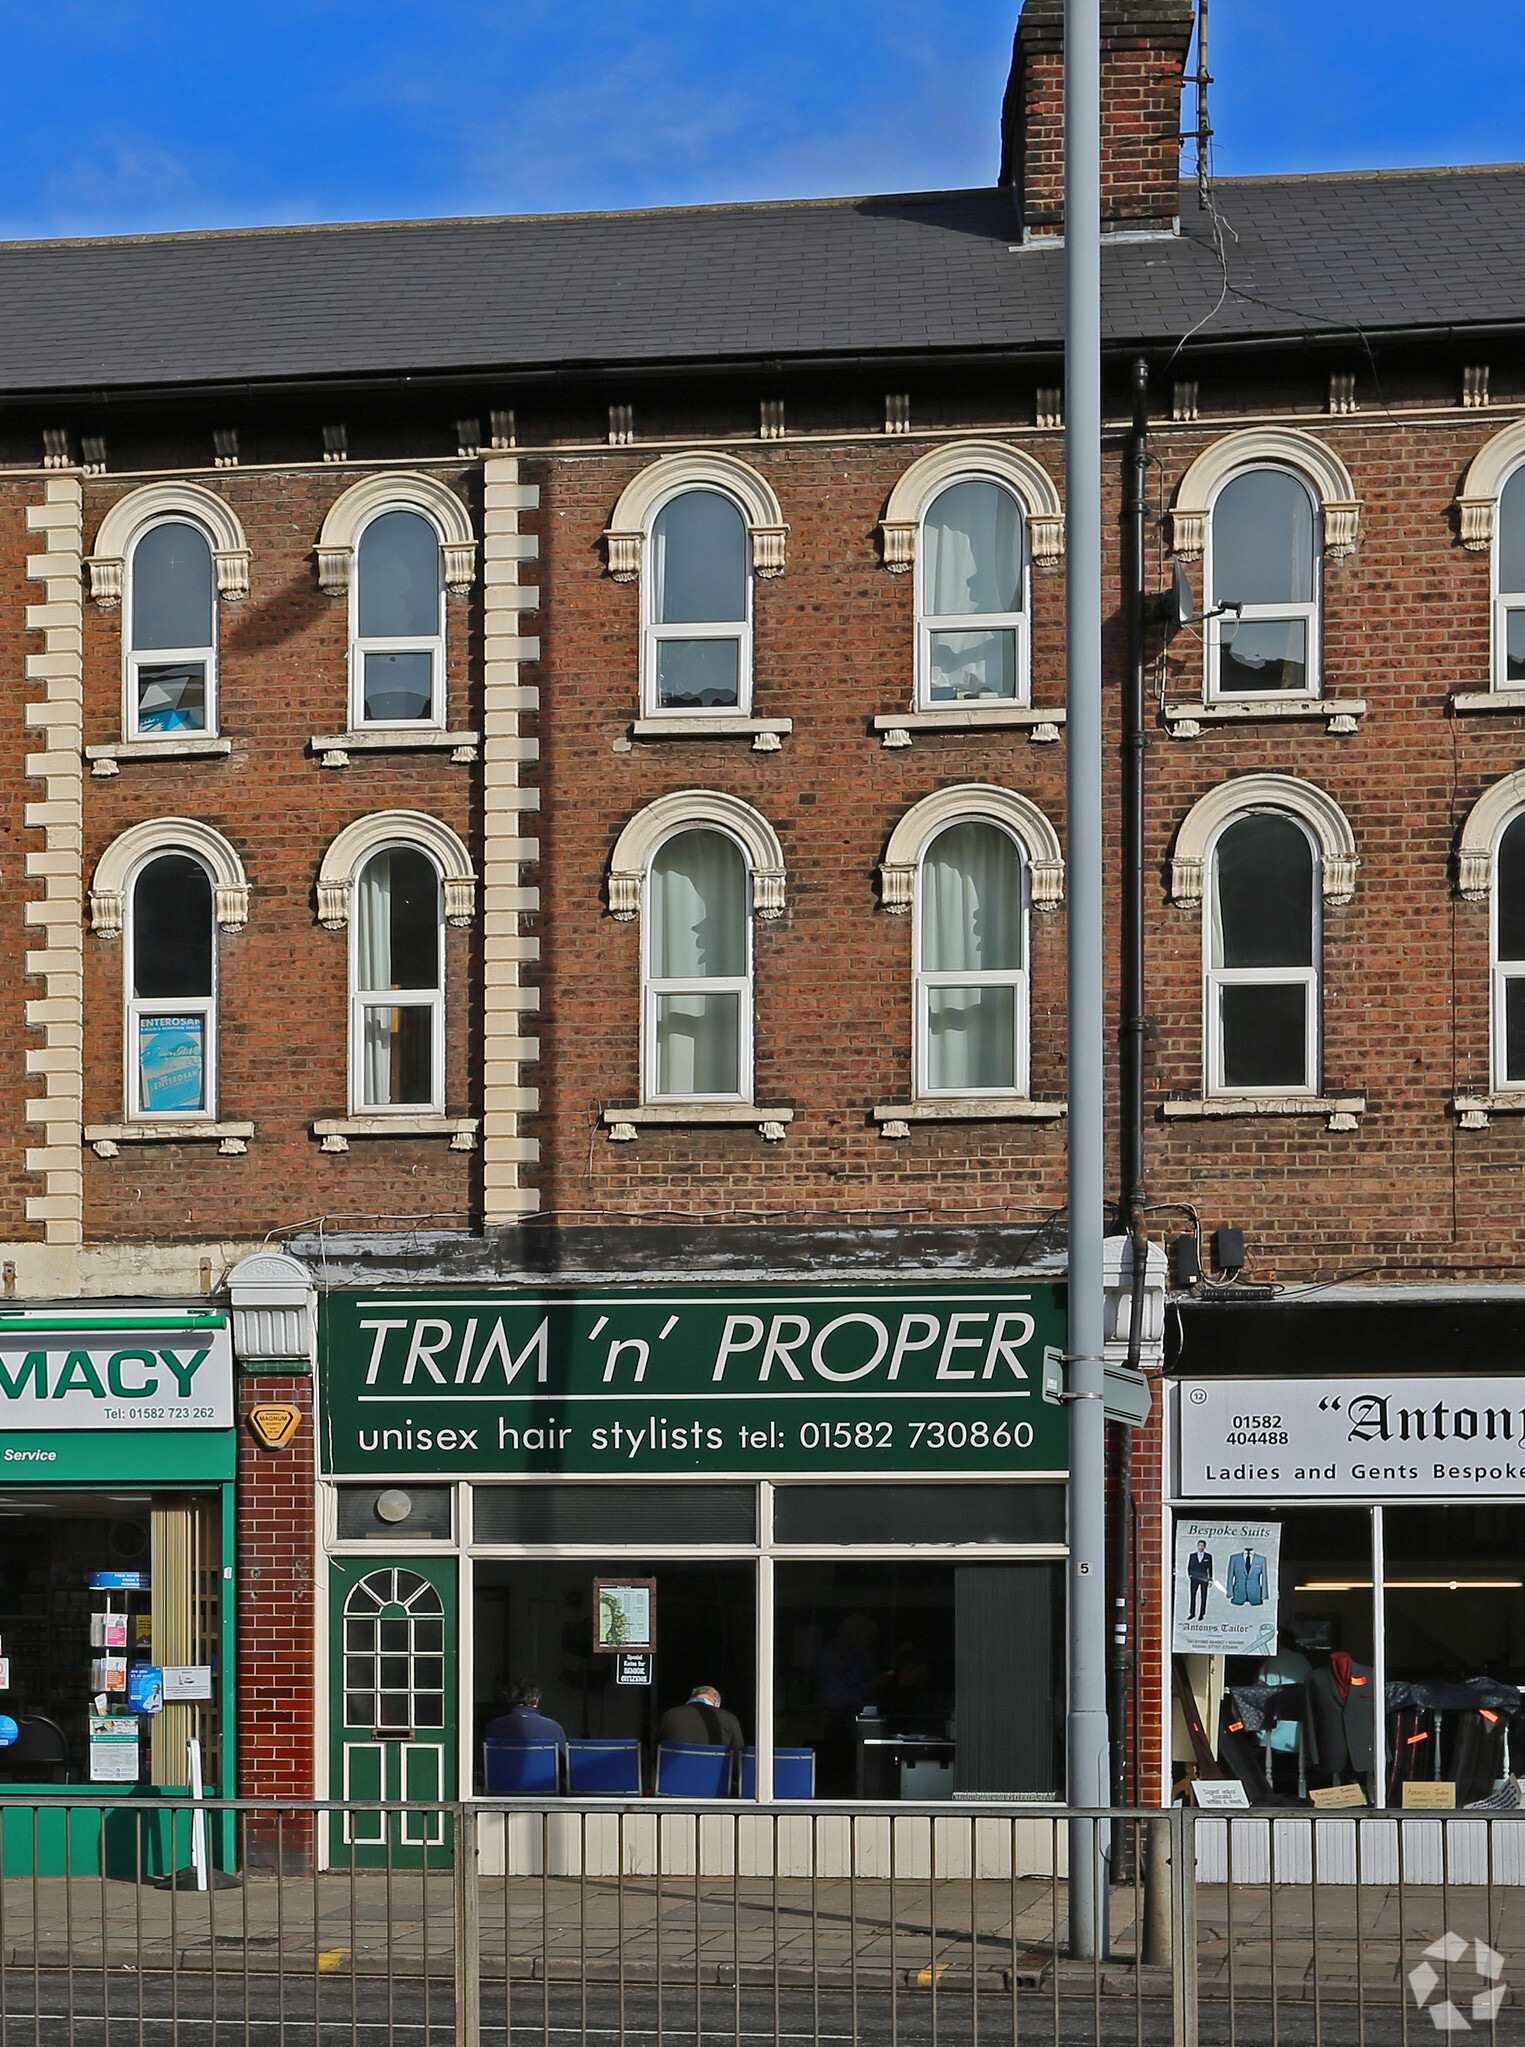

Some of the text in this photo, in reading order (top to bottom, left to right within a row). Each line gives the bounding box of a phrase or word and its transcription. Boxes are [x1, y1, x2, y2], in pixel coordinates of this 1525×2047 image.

[359, 1315, 549, 1385] TRIM
[711, 1312, 1036, 1382] PROPER
[1193, 1392, 1204, 1400] 12
[104, 1407, 214, 1419] Tel: 01582 723 262
[1233, 1415, 1282, 1429] 01582
[358, 1416, 1035, 1459] unisex hair stylists tel: 01582 730860
[1226, 1431, 1289, 1445] 404488
[4, 1449, 57, 1461] Service
[1206, 1464, 1280, 1480] Ladies
[1294, 1463, 1337, 1480] and
[1351, 1463, 1418, 1480] Gents
[1188, 1524, 1270, 1538] Bespoke Suits
[1080, 1563, 1089, 1574] 5
